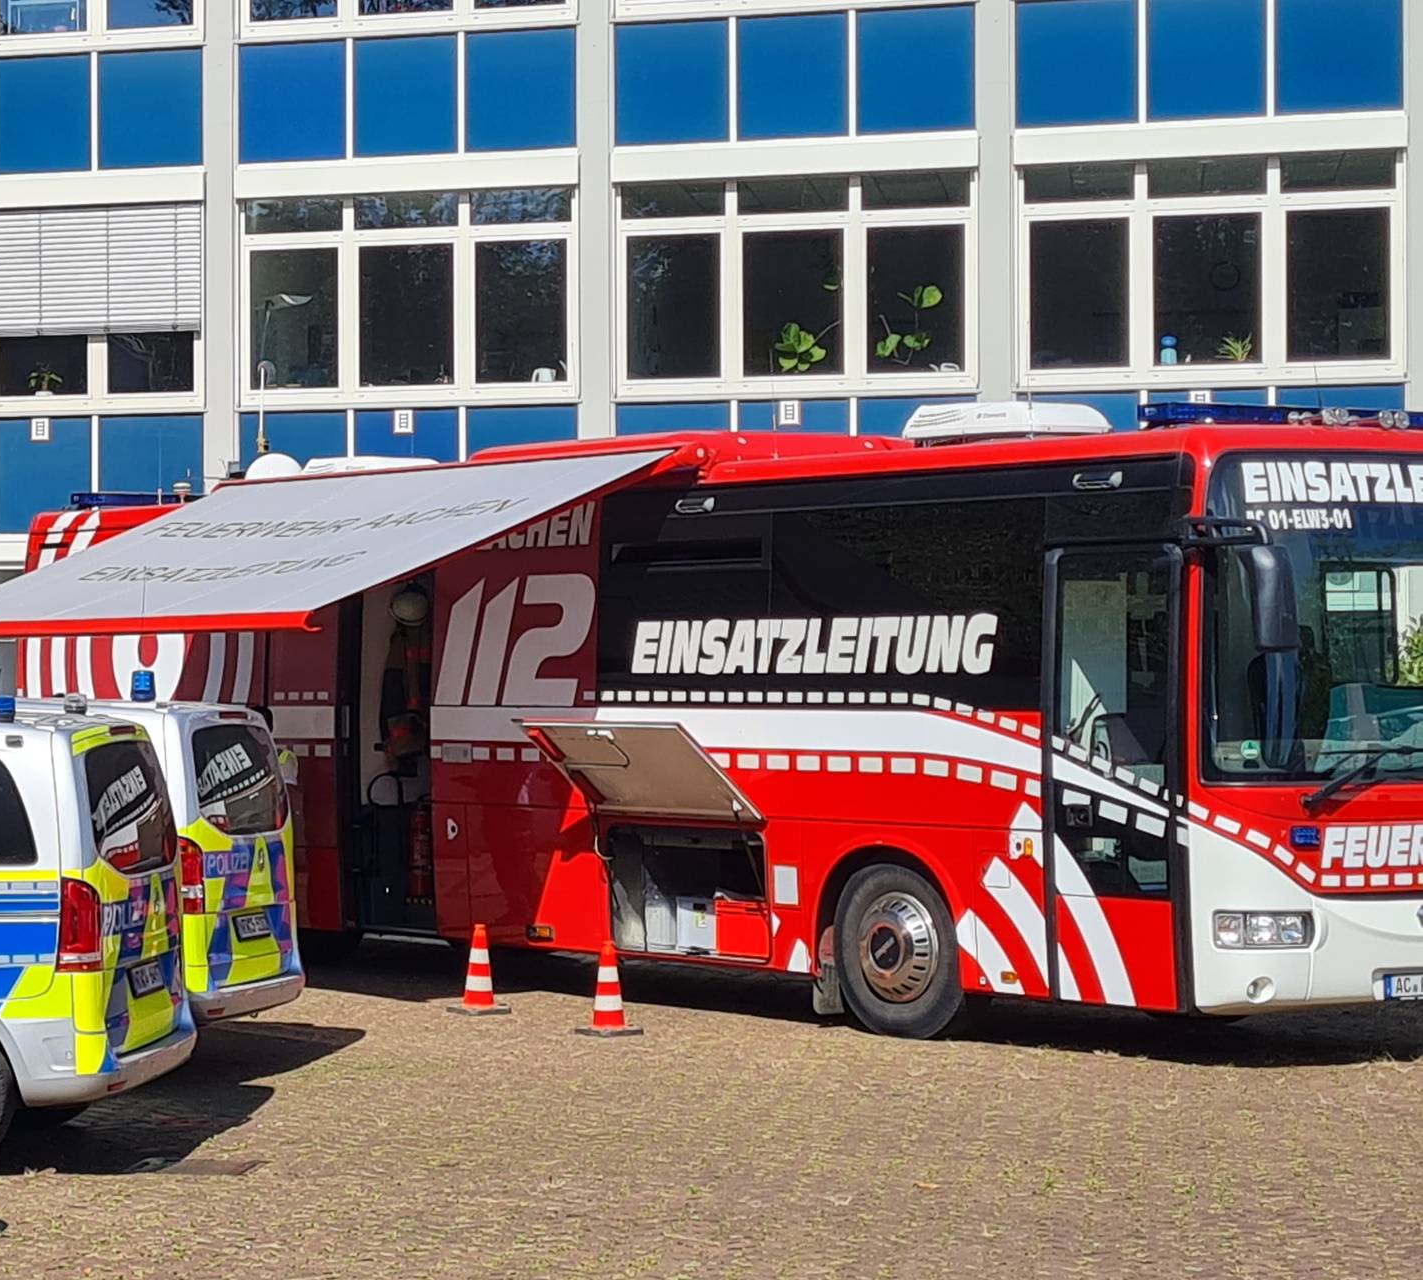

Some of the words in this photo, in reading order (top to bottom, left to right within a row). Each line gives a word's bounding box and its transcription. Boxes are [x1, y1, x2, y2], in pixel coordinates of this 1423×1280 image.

[142, 518, 361, 539] FEUERWEHR
[353, 497, 530, 530] AACHEN
[477, 501, 596, 550] HEN
[78, 550, 368, 582] EINSATZLEITUNG
[433, 572, 596, 706] 112
[631, 613, 998, 675] EINSATZLEITUNG
